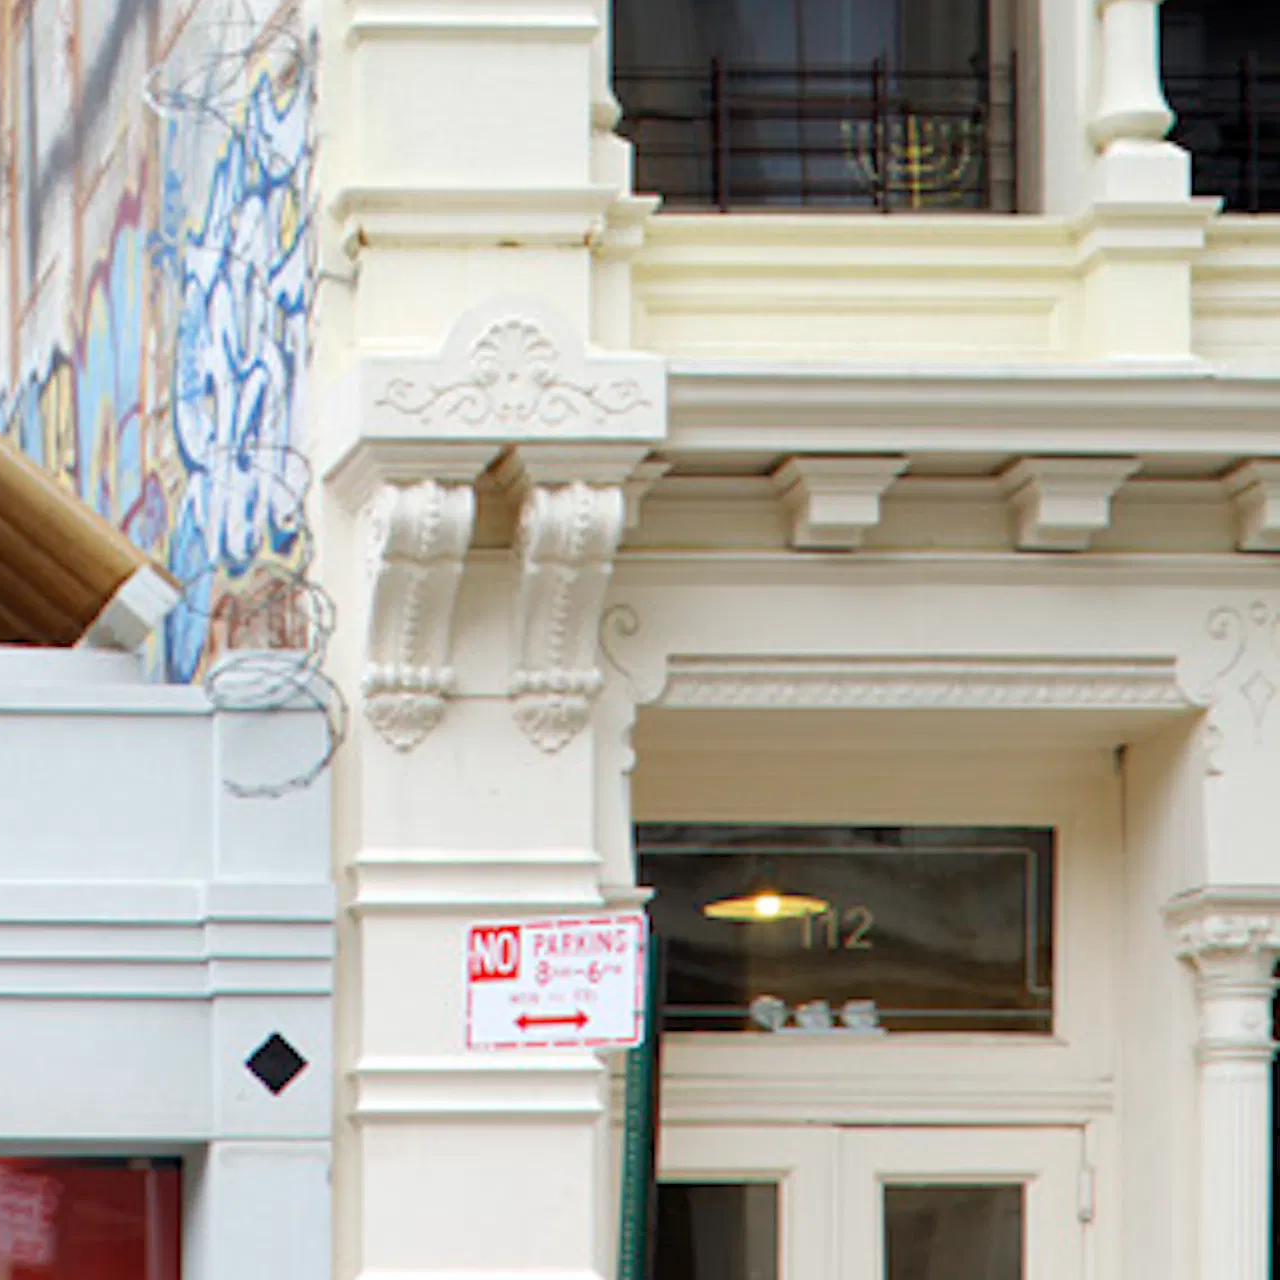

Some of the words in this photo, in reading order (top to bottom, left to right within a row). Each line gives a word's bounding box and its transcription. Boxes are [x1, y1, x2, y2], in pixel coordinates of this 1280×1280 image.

[799, 903, 874, 951] 112
[473, 929, 518, 976] NO
[534, 928, 627, 957] PARKING
